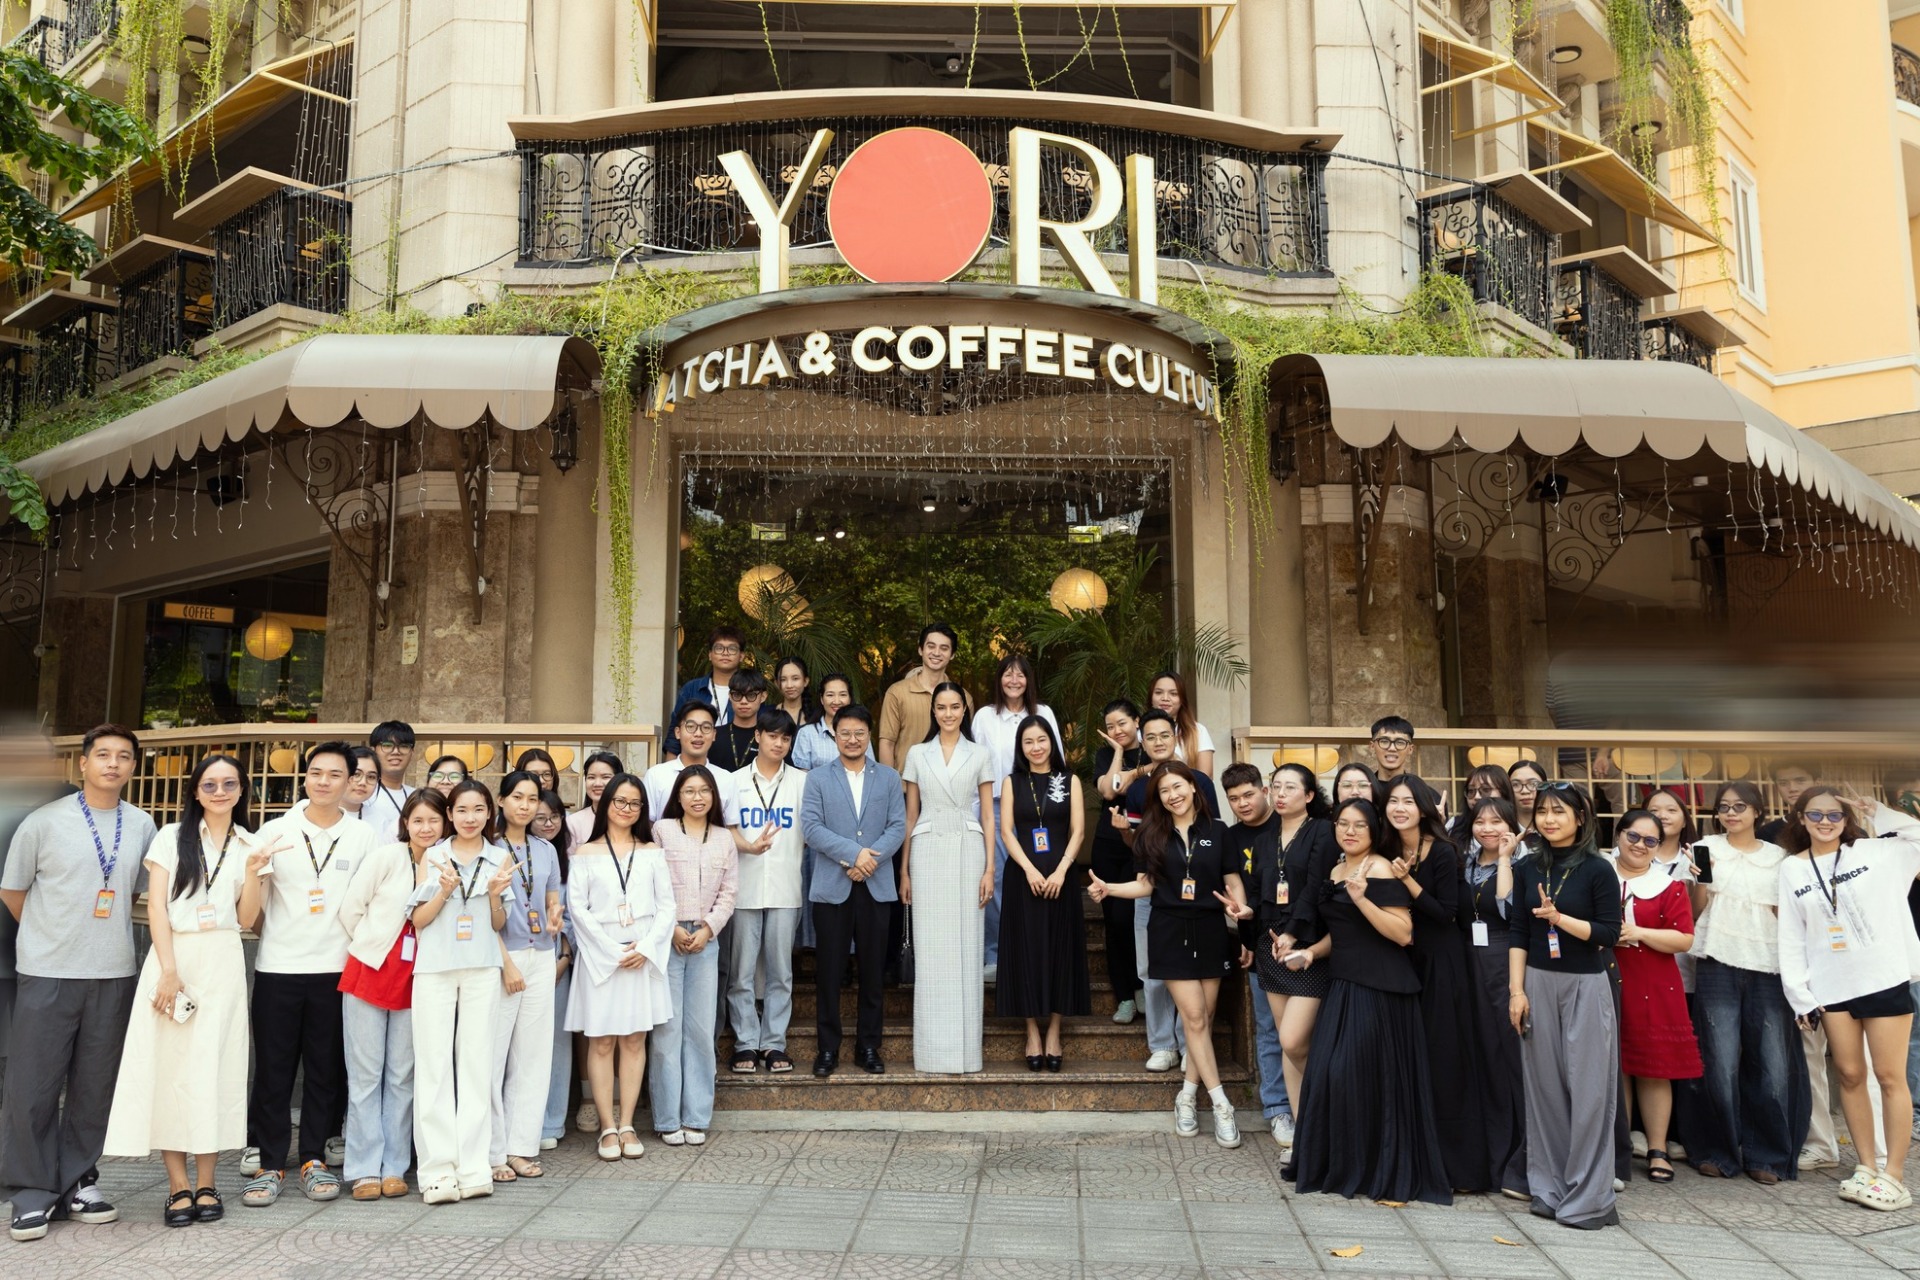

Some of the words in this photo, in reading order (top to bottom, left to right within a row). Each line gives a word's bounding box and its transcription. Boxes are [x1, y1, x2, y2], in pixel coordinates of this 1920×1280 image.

[717, 127, 1158, 304] YORI
[799, 331, 837, 376] &
[852, 325, 1095, 380] COFFEE
[1106, 342, 1221, 423] CULTUR
[183, 605, 216, 620] COFFEE
[1794, 884, 1812, 898] BAD
